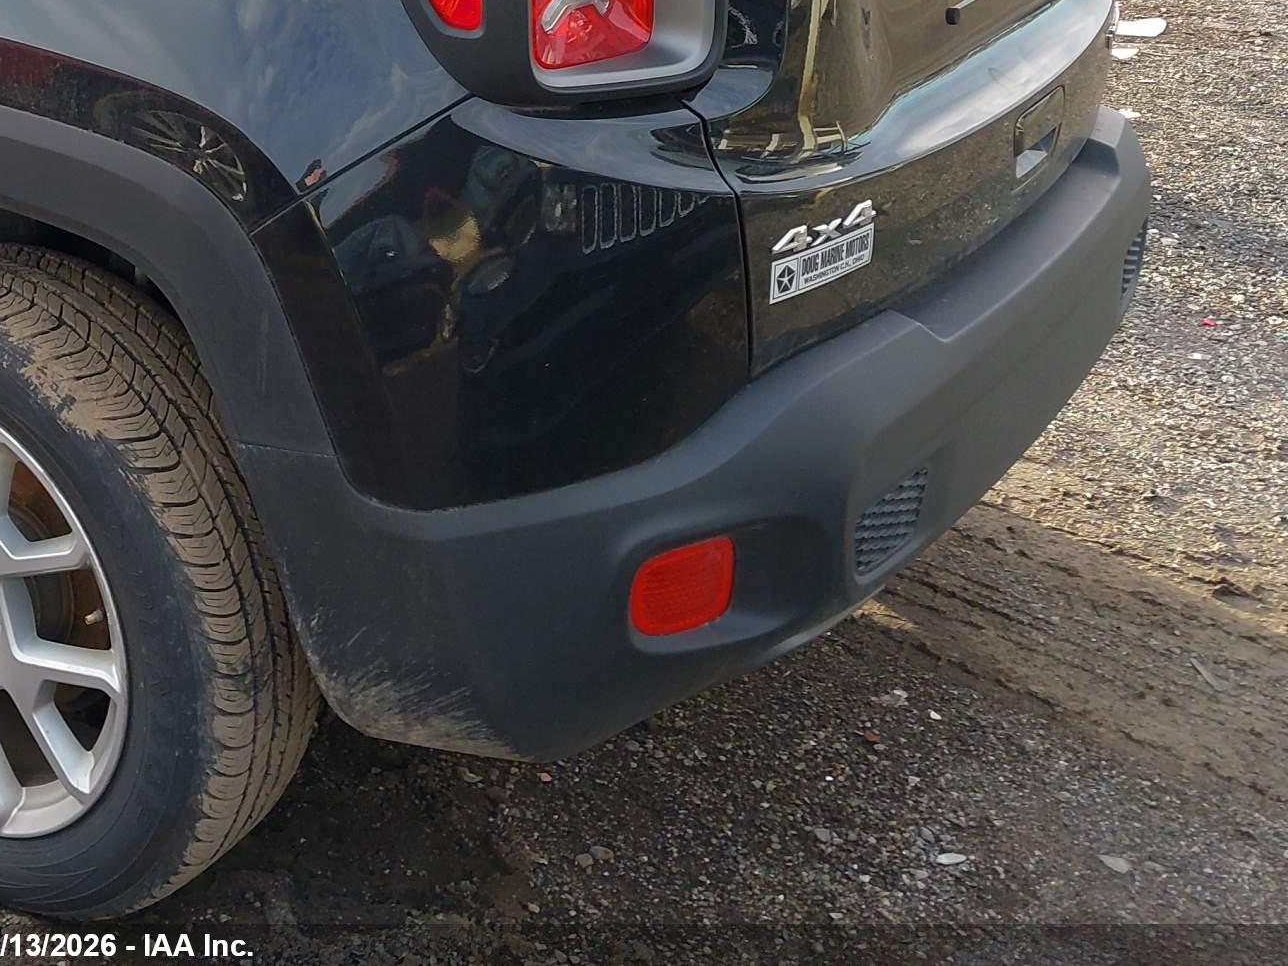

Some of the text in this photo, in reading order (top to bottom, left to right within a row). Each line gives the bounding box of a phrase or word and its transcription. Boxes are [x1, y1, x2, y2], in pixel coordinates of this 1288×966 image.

[772, 199, 876, 254] 4x4
[801, 253, 819, 276] DOUG
[846, 233, 870, 261] MOTORS
